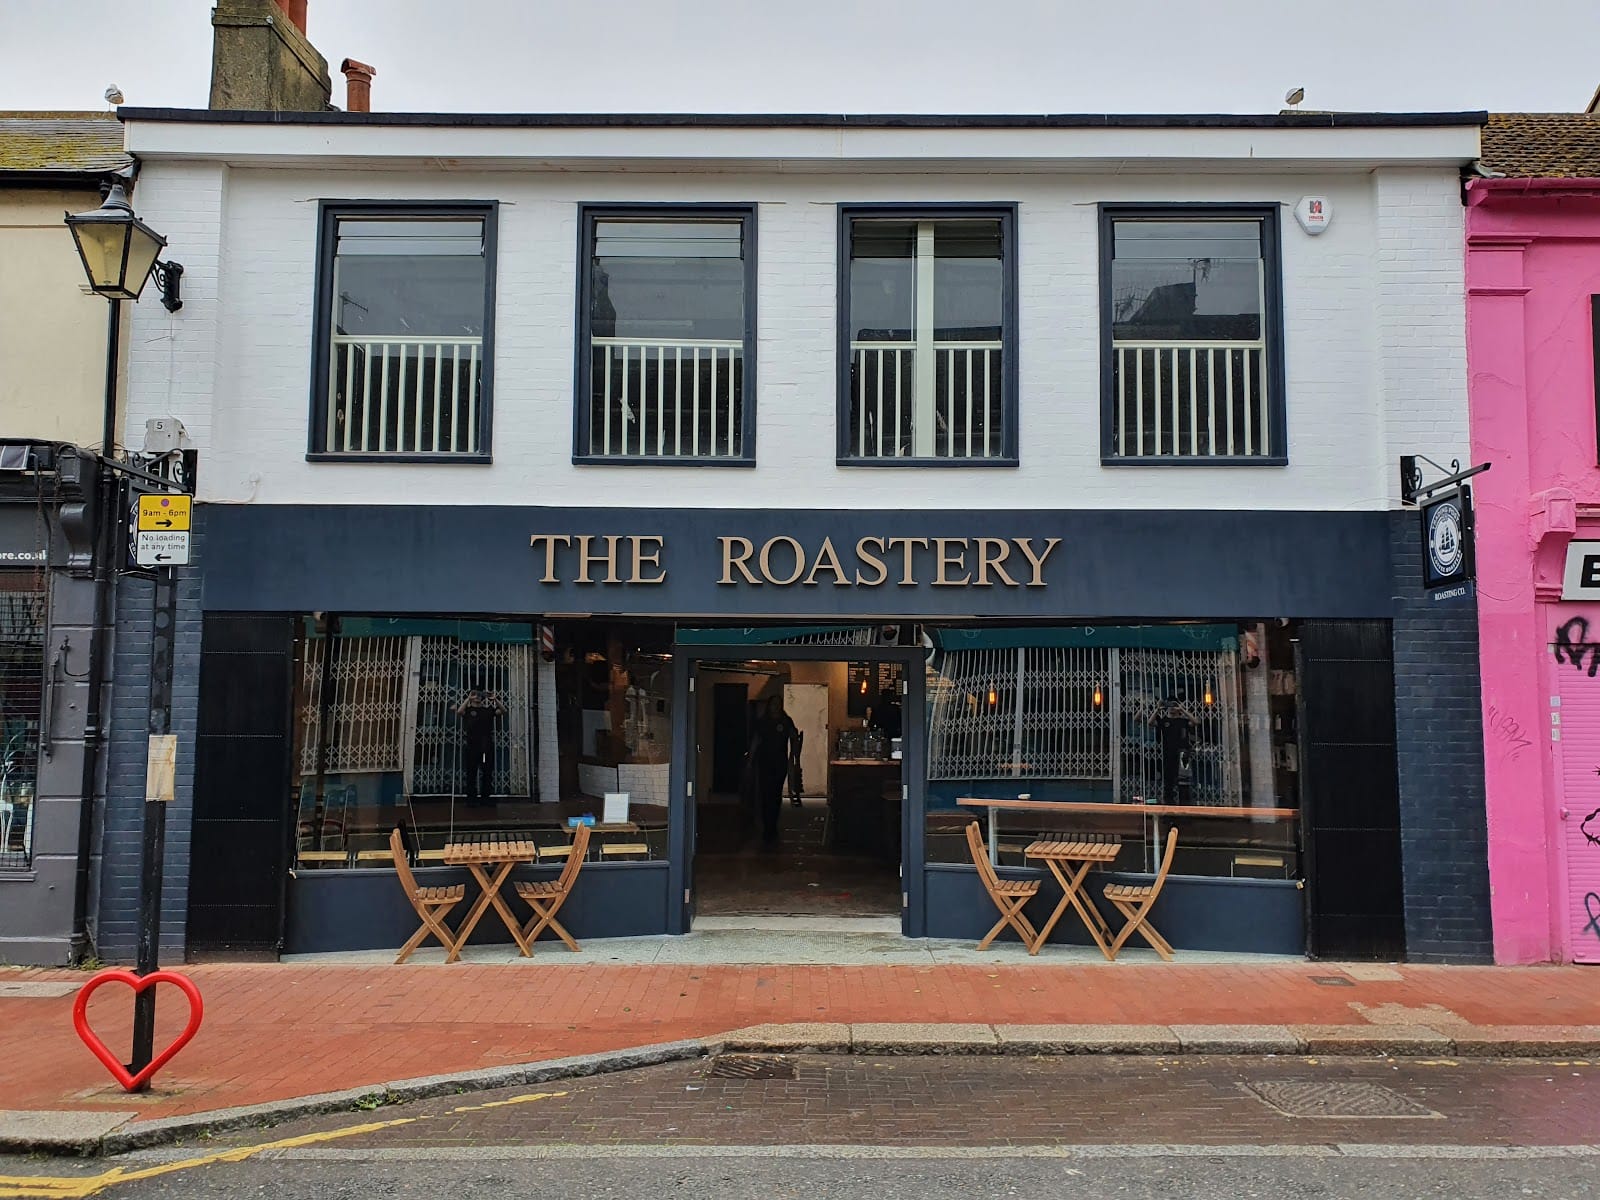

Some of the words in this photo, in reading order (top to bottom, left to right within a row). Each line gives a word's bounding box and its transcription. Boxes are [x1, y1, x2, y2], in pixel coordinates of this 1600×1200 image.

[156, 421, 163, 430] 5
[143, 509, 161, 517] 9am
[168, 509, 187, 518] 6pm
[156, 534, 186, 543] loading
[151, 544, 166, 552] any
[530, 534, 667, 585] THE
[716, 535, 1063, 587] ROASTERY
